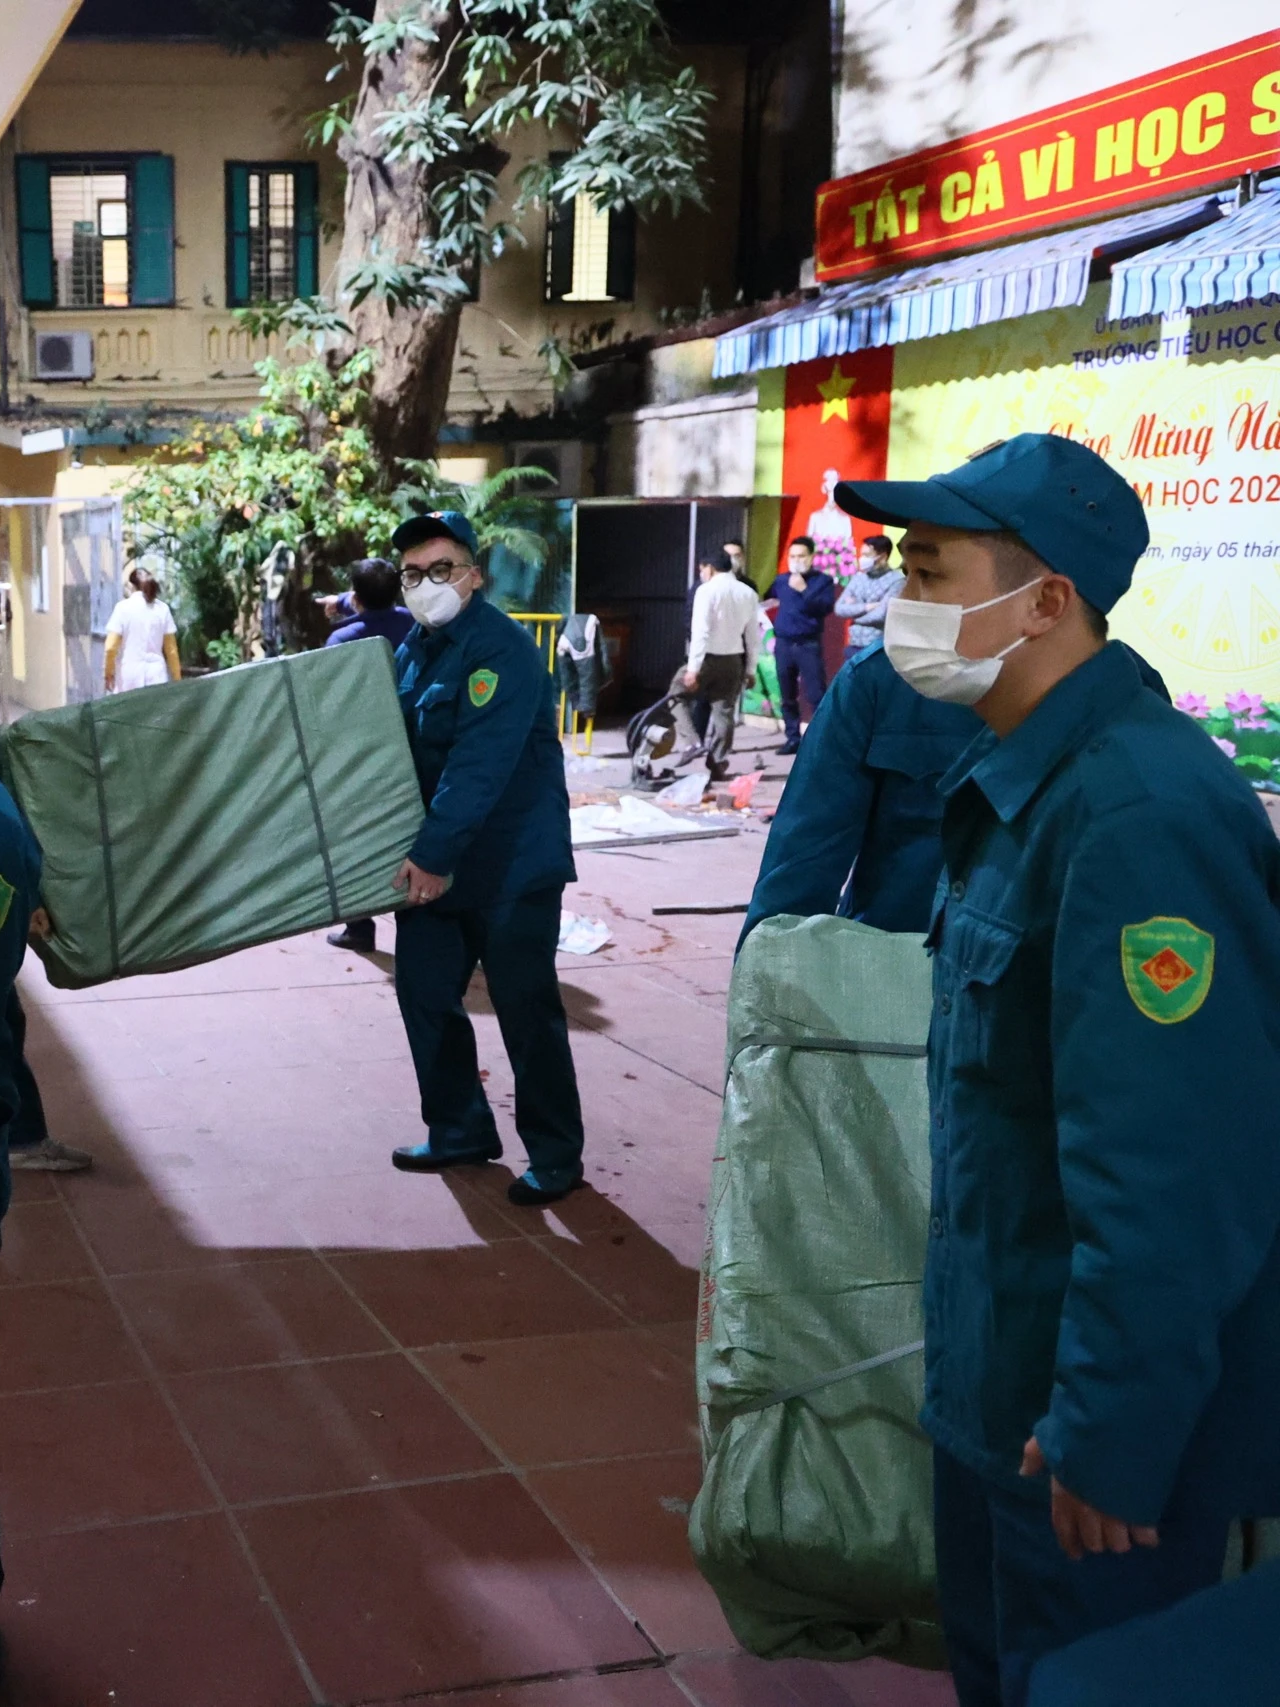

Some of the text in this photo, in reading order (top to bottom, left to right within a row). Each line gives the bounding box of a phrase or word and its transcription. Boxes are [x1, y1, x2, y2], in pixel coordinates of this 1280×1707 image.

[849, 180, 925, 248] TẤT
[940, 149, 1005, 224] CẢ
[1019, 132, 1075, 202] VÌ
[1094, 92, 1226, 183] HỌC
[1216, 321, 1268, 354] HỌC
[1119, 412, 1214, 466] Mừng
[1161, 477, 1220, 512] HỌC
[1170, 541, 1212, 562] ngày
[1216, 541, 1238, 558] 05
